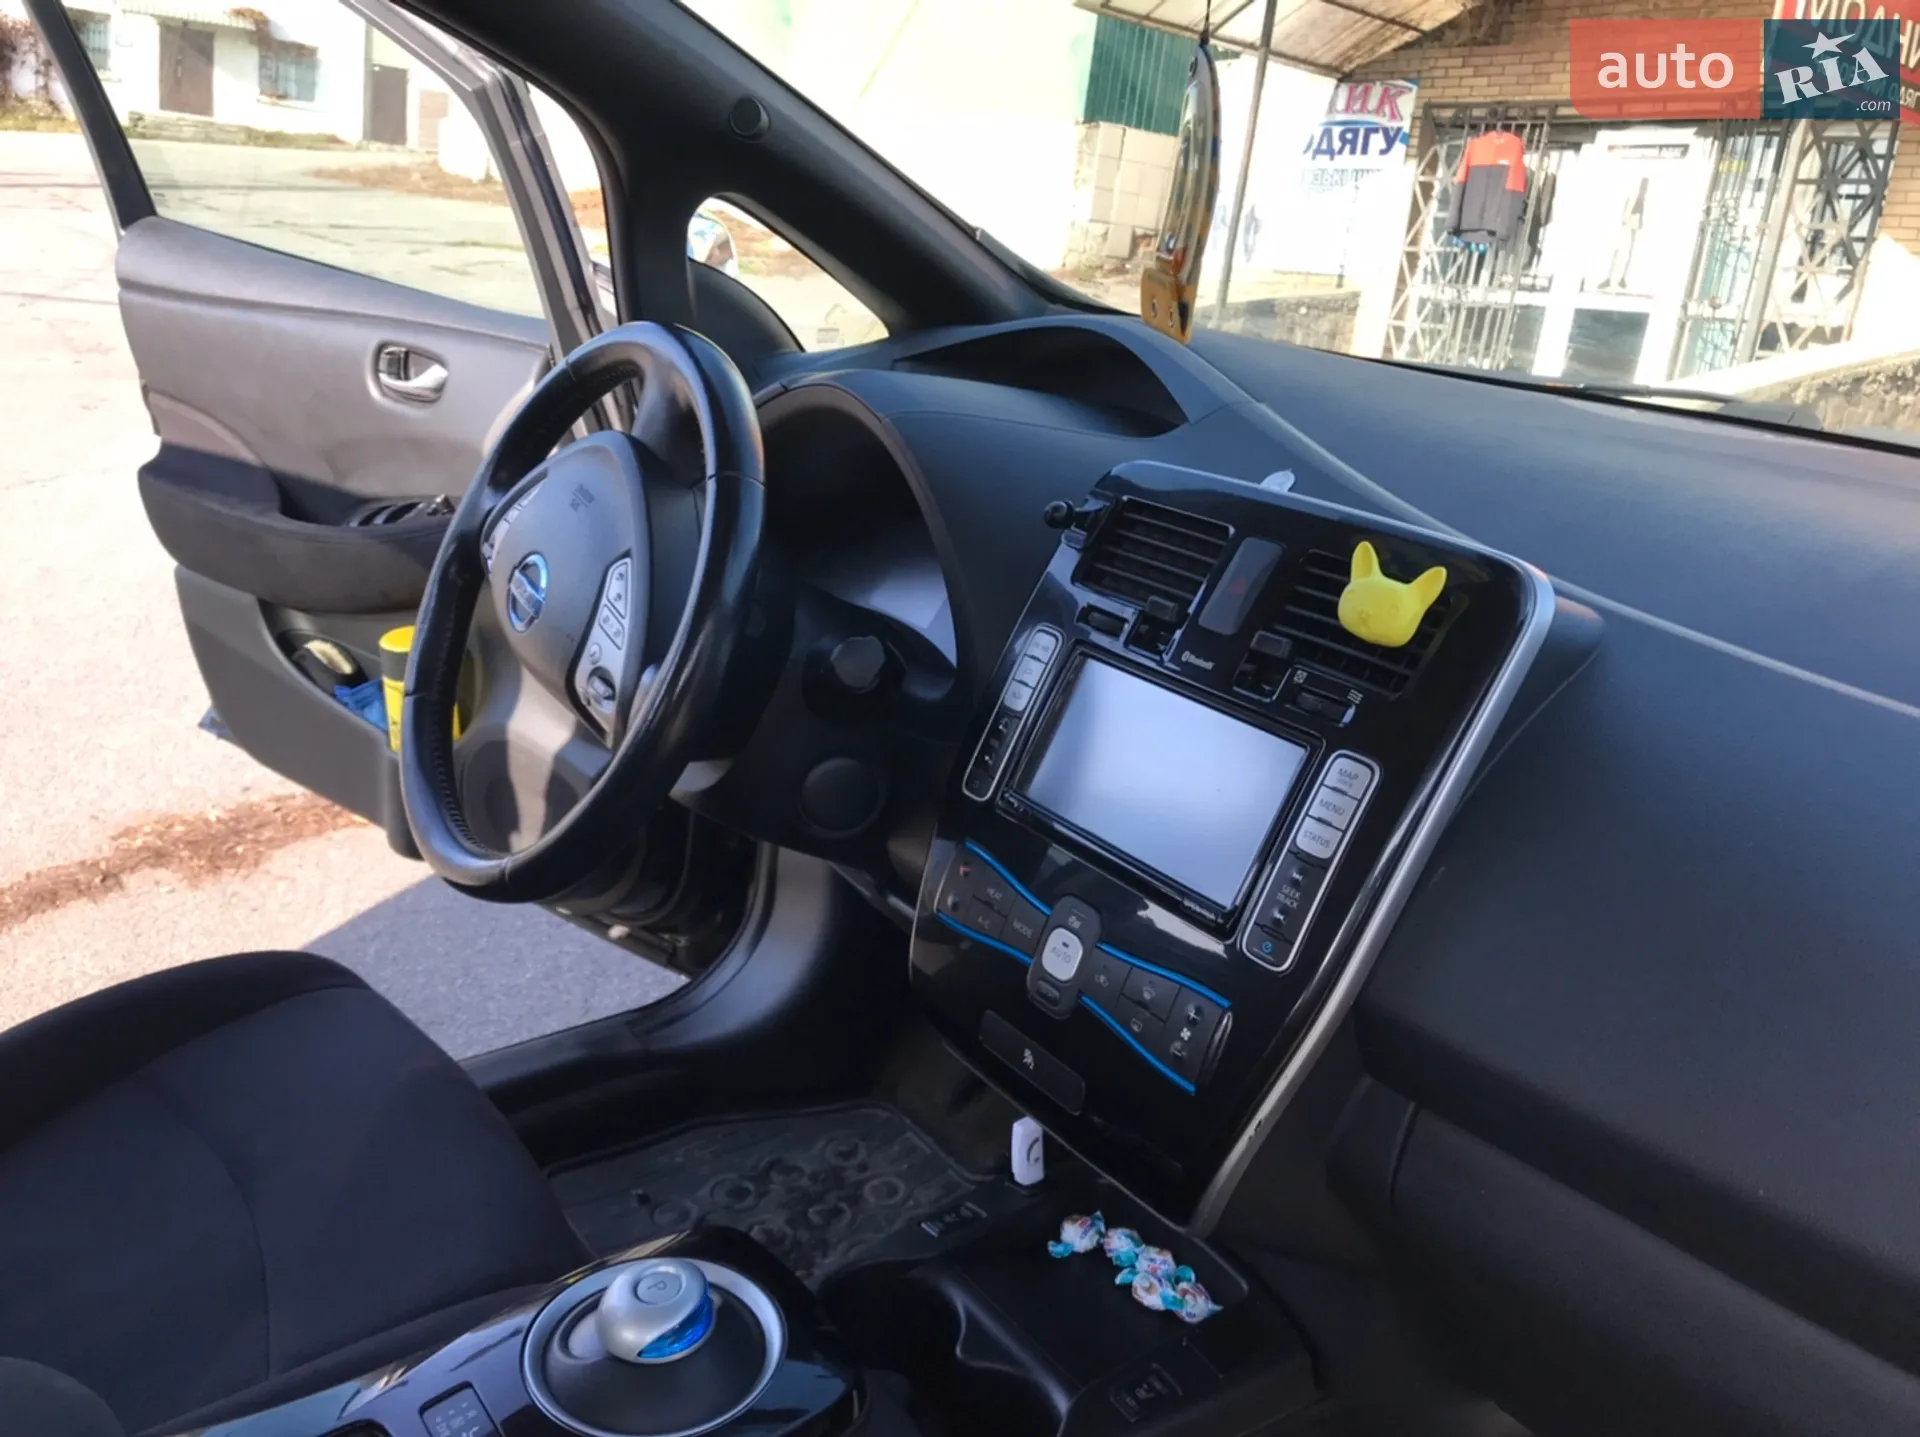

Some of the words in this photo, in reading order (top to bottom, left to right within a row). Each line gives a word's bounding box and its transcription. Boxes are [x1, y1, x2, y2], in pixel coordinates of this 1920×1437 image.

[1338, 767, 1359, 780] MAP
[1319, 798, 1345, 816] MENU
[1303, 829, 1331, 848] STATUS
[1012, 918, 1033, 939] MODE
[1050, 945, 1073, 964] AUTO
[648, 1279, 668, 1292] P
